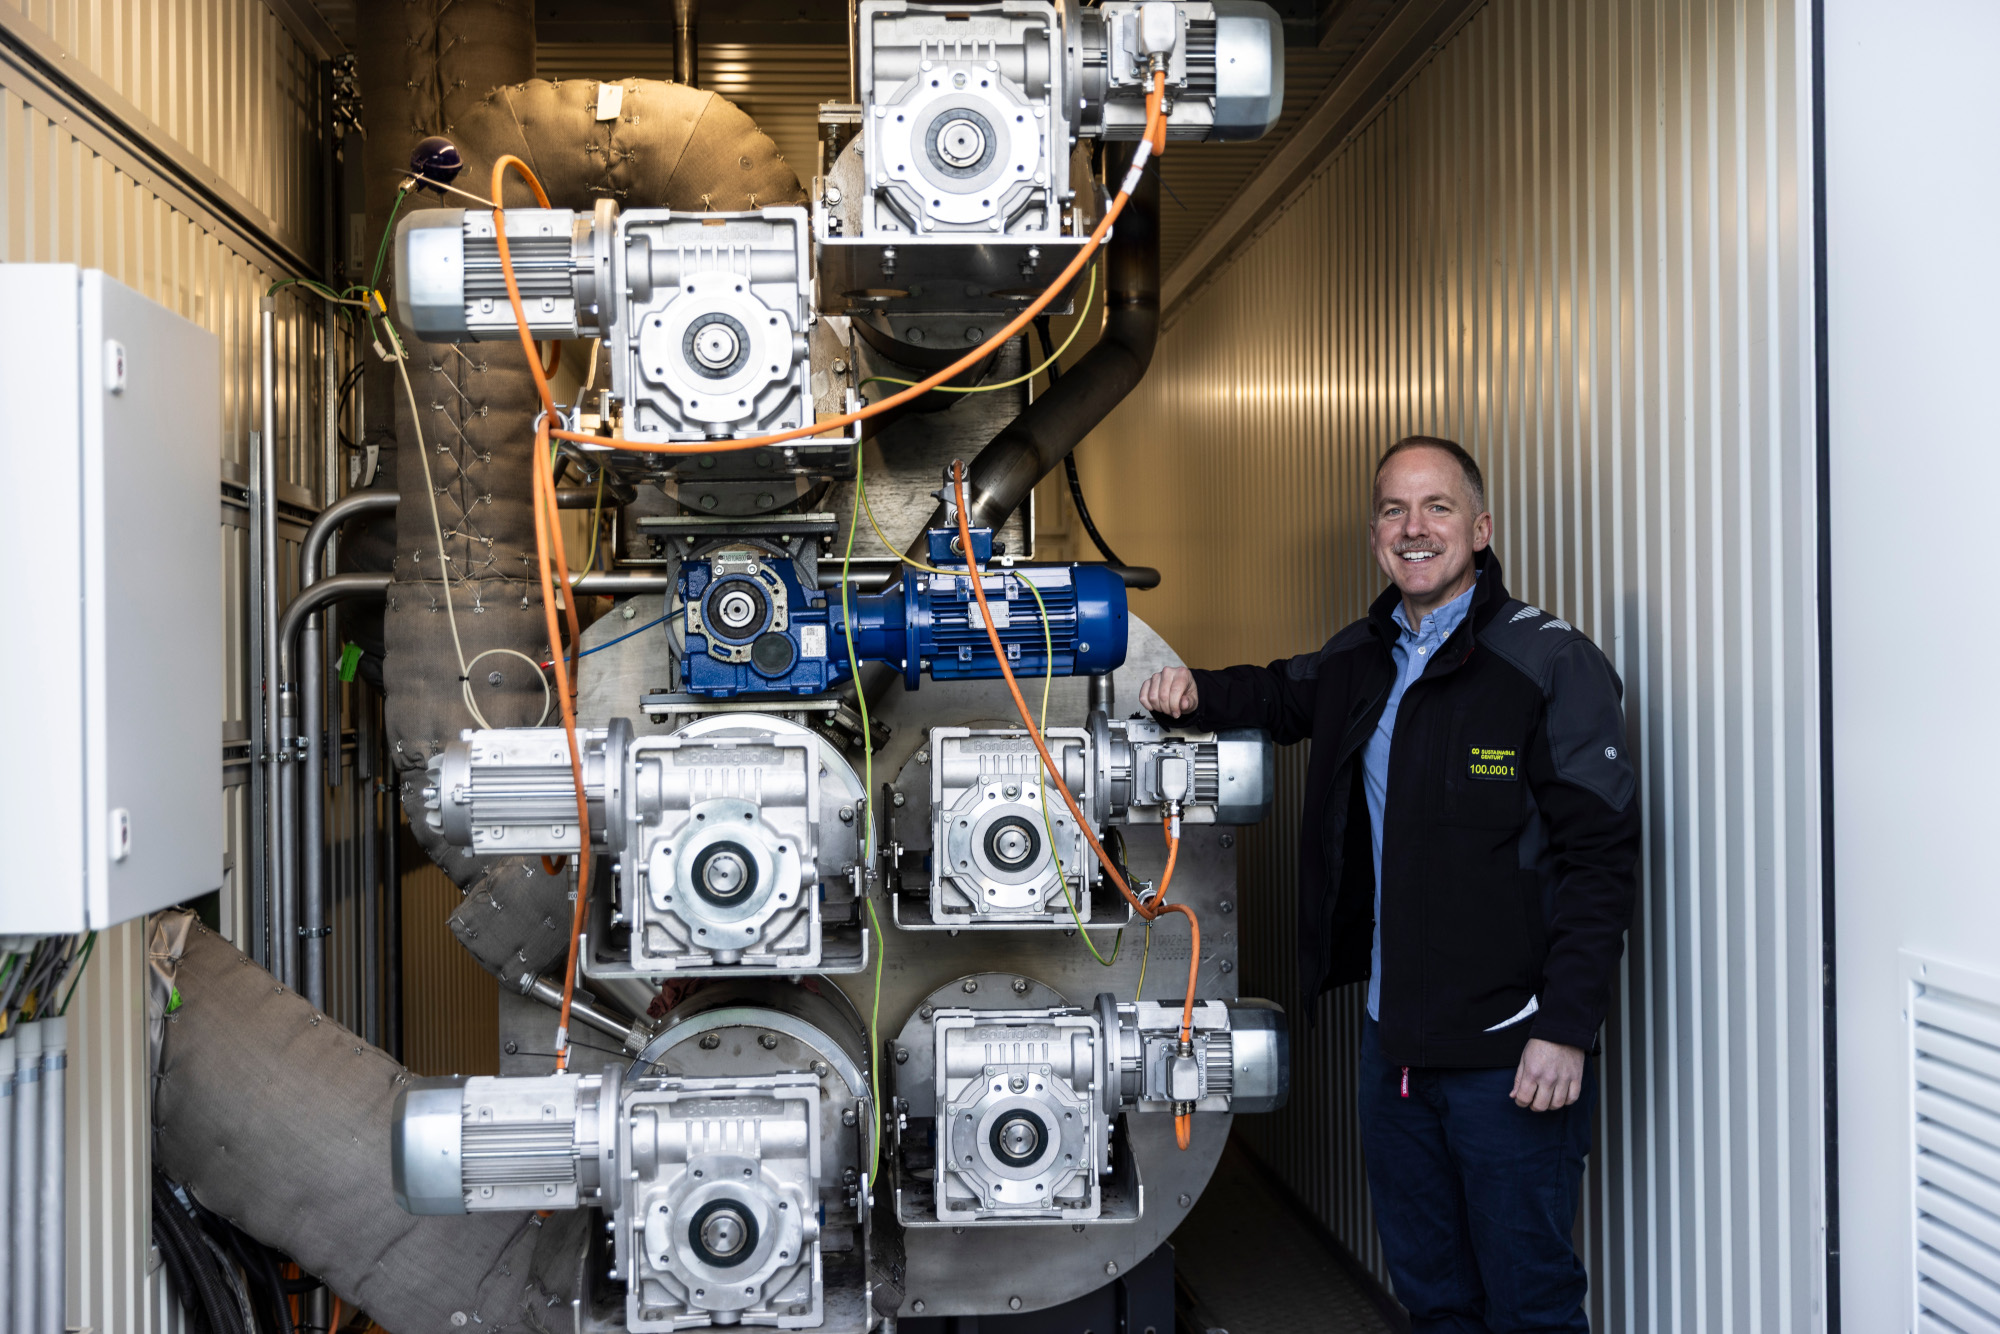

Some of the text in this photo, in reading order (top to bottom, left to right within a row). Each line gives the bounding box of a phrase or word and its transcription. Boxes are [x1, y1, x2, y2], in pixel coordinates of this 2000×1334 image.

[973, 739, 1038, 753] Bonfiglio
[1470, 764, 1515, 776] 100.000 t
